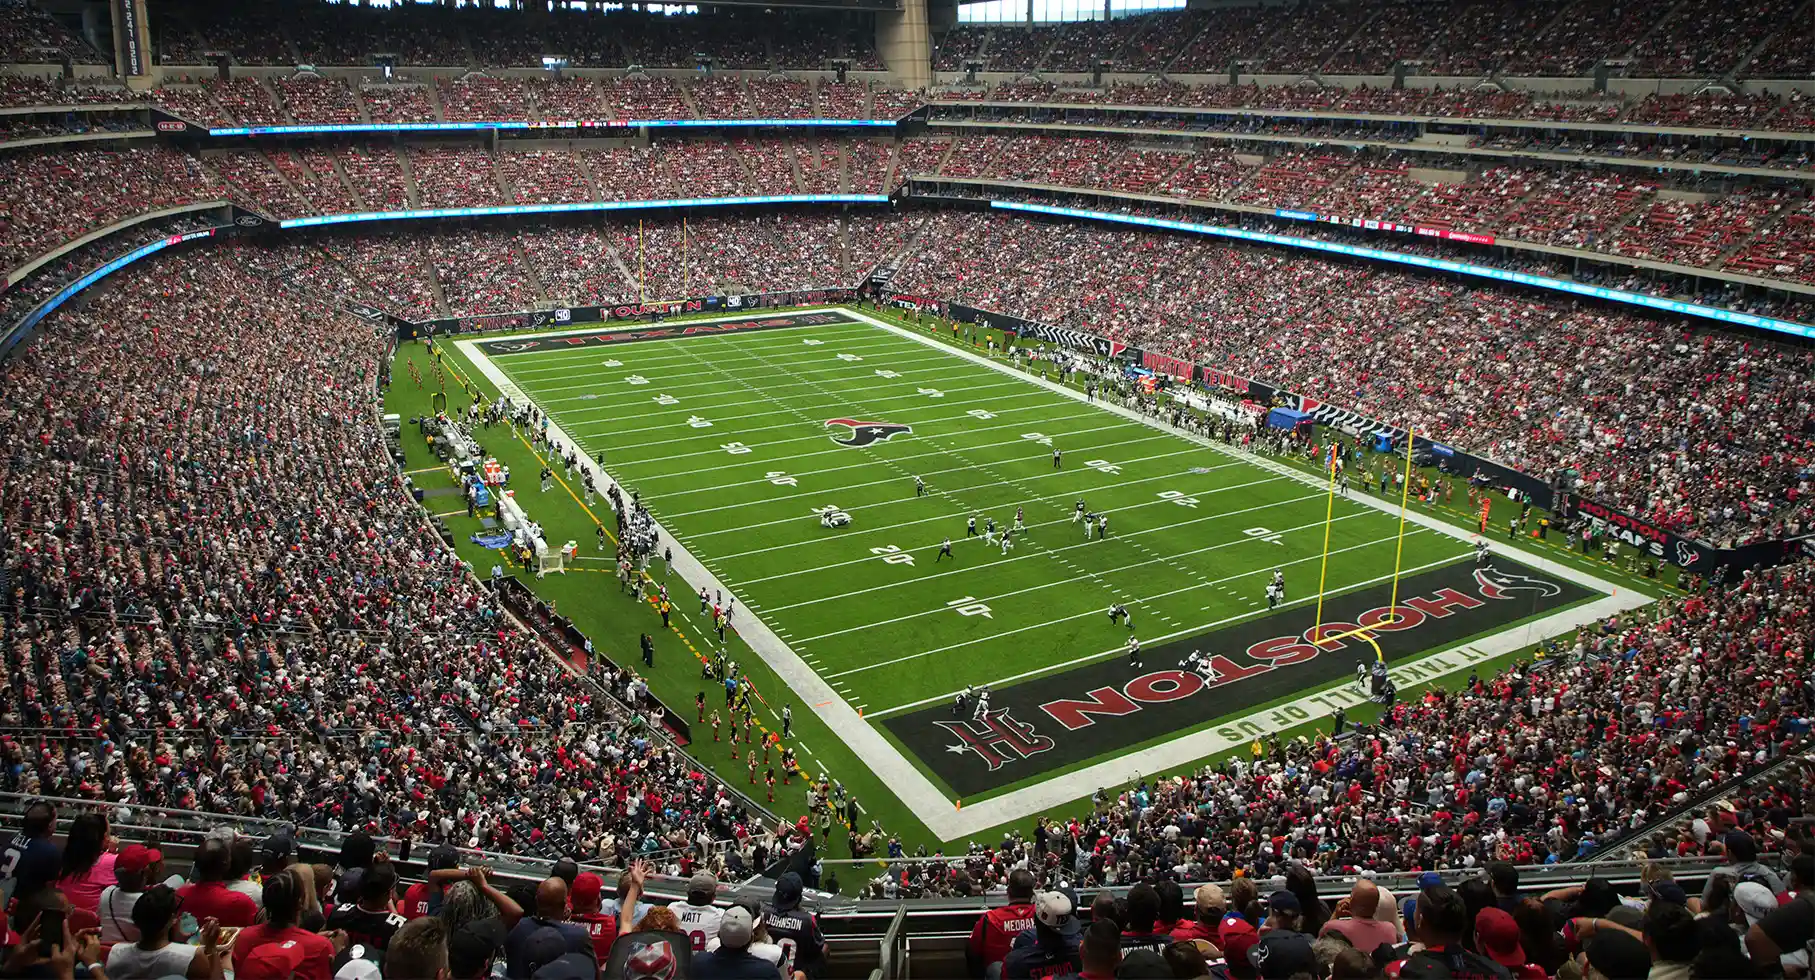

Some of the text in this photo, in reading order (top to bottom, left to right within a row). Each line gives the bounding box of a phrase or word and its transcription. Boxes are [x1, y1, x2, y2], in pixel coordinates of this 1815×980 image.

[1156, 490, 1200, 508] 20
[1578, 500, 1668, 545] HOUSTON
[1242, 526, 1284, 545] 10
[869, 544, 915, 567] 20
[946, 596, 993, 619] 10
[1038, 588, 1485, 731] HOUSTON
[1456, 646, 1488, 661] IT
[1270, 705, 1311, 727] OF
[1217, 720, 1266, 742] US
[681, 911, 702, 923] WATT
[766, 913, 803, 931] JOHNSON
